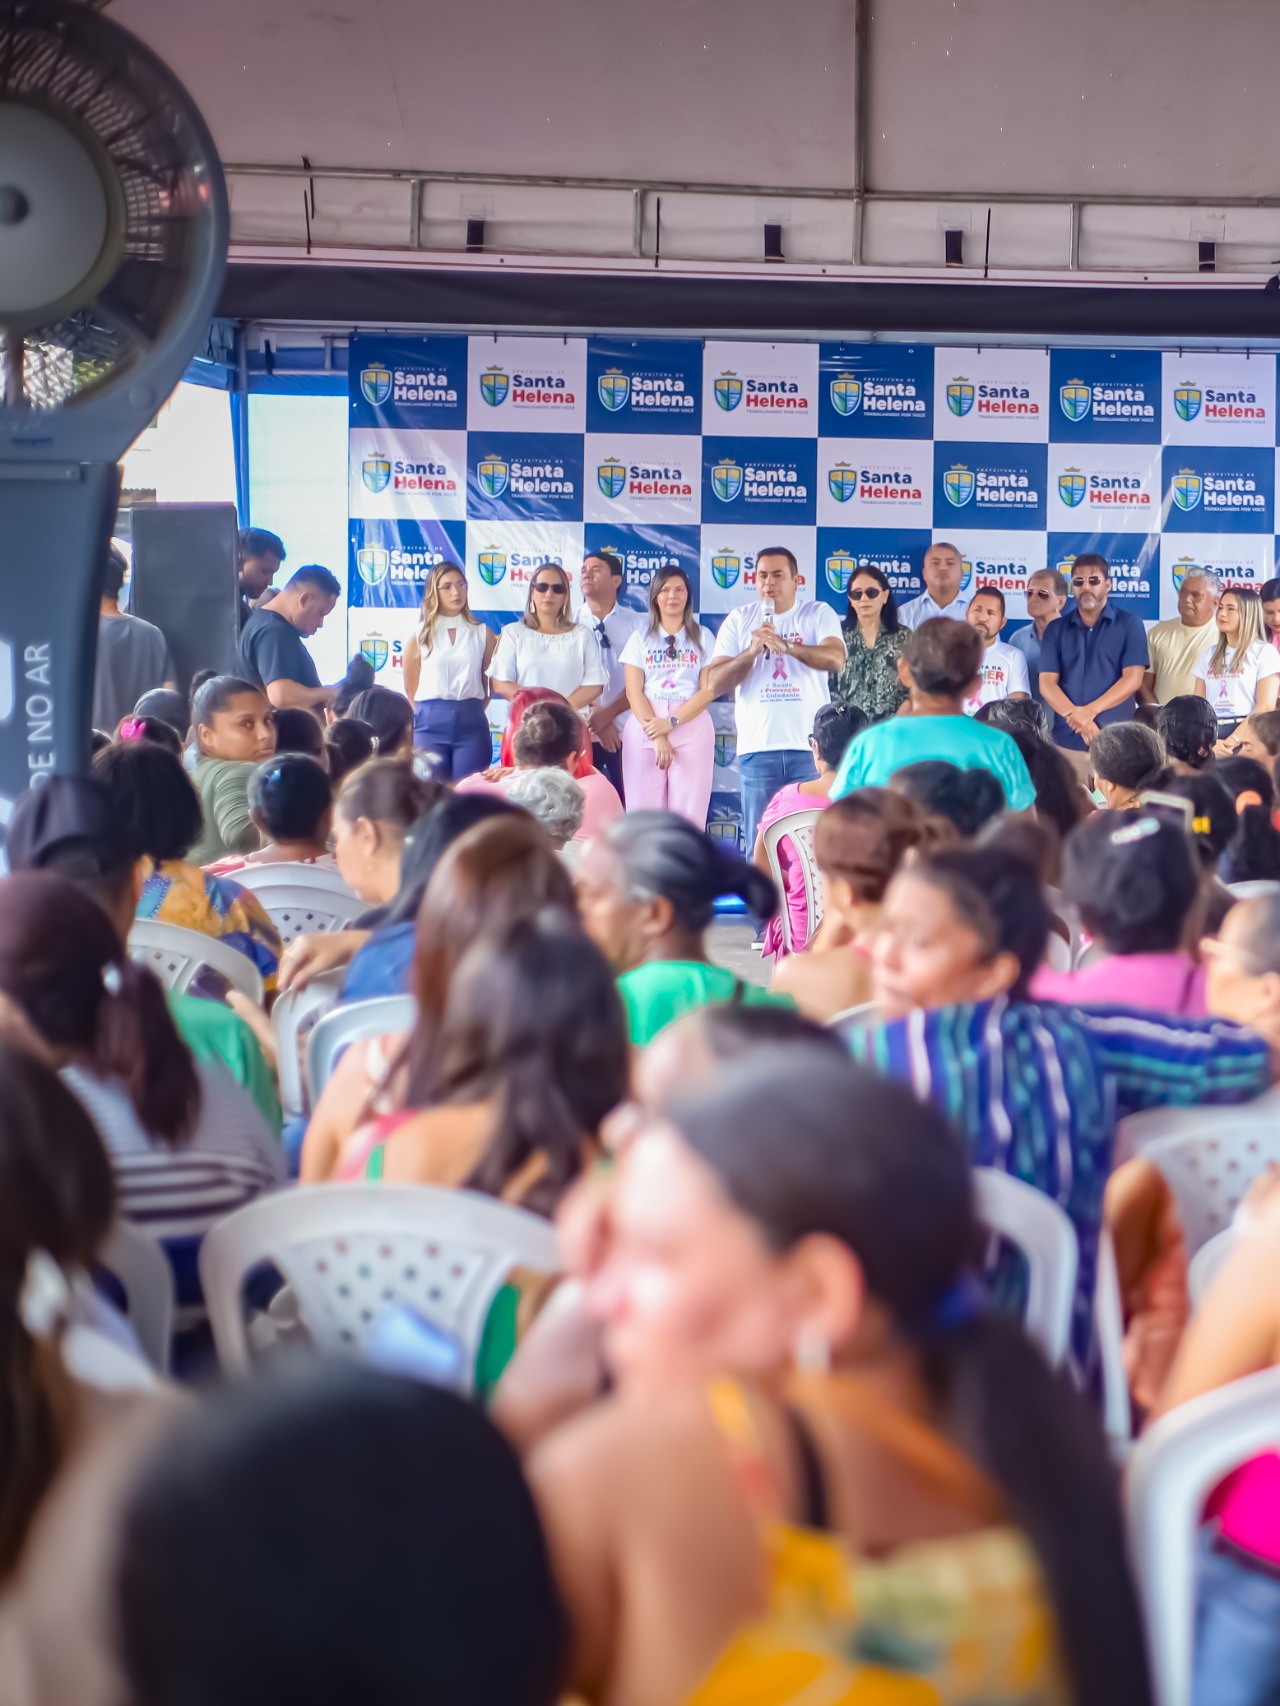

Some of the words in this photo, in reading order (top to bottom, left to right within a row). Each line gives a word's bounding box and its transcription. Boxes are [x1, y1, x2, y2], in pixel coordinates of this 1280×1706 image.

[395, 372, 447, 386] Santa
[513, 375, 565, 388] Santa
[632, 377, 685, 391] Santa
[394, 387, 457, 401] Helena
[747, 380, 798, 394] Santa
[863, 382, 915, 396] Santa
[979, 385, 1030, 399] Santa
[1093, 387, 1144, 401] Santa
[512, 390, 575, 404] Helena
[631, 392, 694, 406] Helena
[746, 395, 808, 409] Helena
[863, 397, 925, 411] Helena
[1205, 390, 1256, 404] Santa
[978, 400, 1039, 414] Helena
[1092, 402, 1154, 416] Helena
[1205, 405, 1265, 419] Helena
[395, 462, 446, 475] Santa
[511, 463, 563, 477] Santa
[630, 466, 682, 480] Santa
[745, 468, 797, 482] Santa
[394, 477, 456, 490] Helena
[510, 478, 574, 492] Helena
[861, 471, 912, 485] Santa
[977, 473, 1028, 487] Santa
[1091, 476, 1141, 490] Santa
[1204, 477, 1255, 491] Santa
[629, 481, 692, 495] Helena
[744, 483, 807, 497] Helena
[860, 486, 922, 500] Helena
[976, 488, 1038, 502] Helena
[1090, 491, 1150, 505] Helena
[1203, 492, 1265, 506] Helena
[390, 550, 444, 565] Santa
[511, 553, 563, 566] Santa
[626, 555, 680, 569] Santa
[390, 565, 429, 580] Hele
[511, 567, 572, 582] Hea
[976, 562, 1027, 575] Santa
[1109, 564, 1141, 578] nta
[626, 570, 653, 584] Hel
[888, 574, 921, 588] ena
[976, 576, 1027, 590] Helen
[1112, 578, 1150, 592] lena
[1219, 579, 1263, 593] elena
[23, 643, 51, 685] AR
[25, 694, 53, 742] NO
